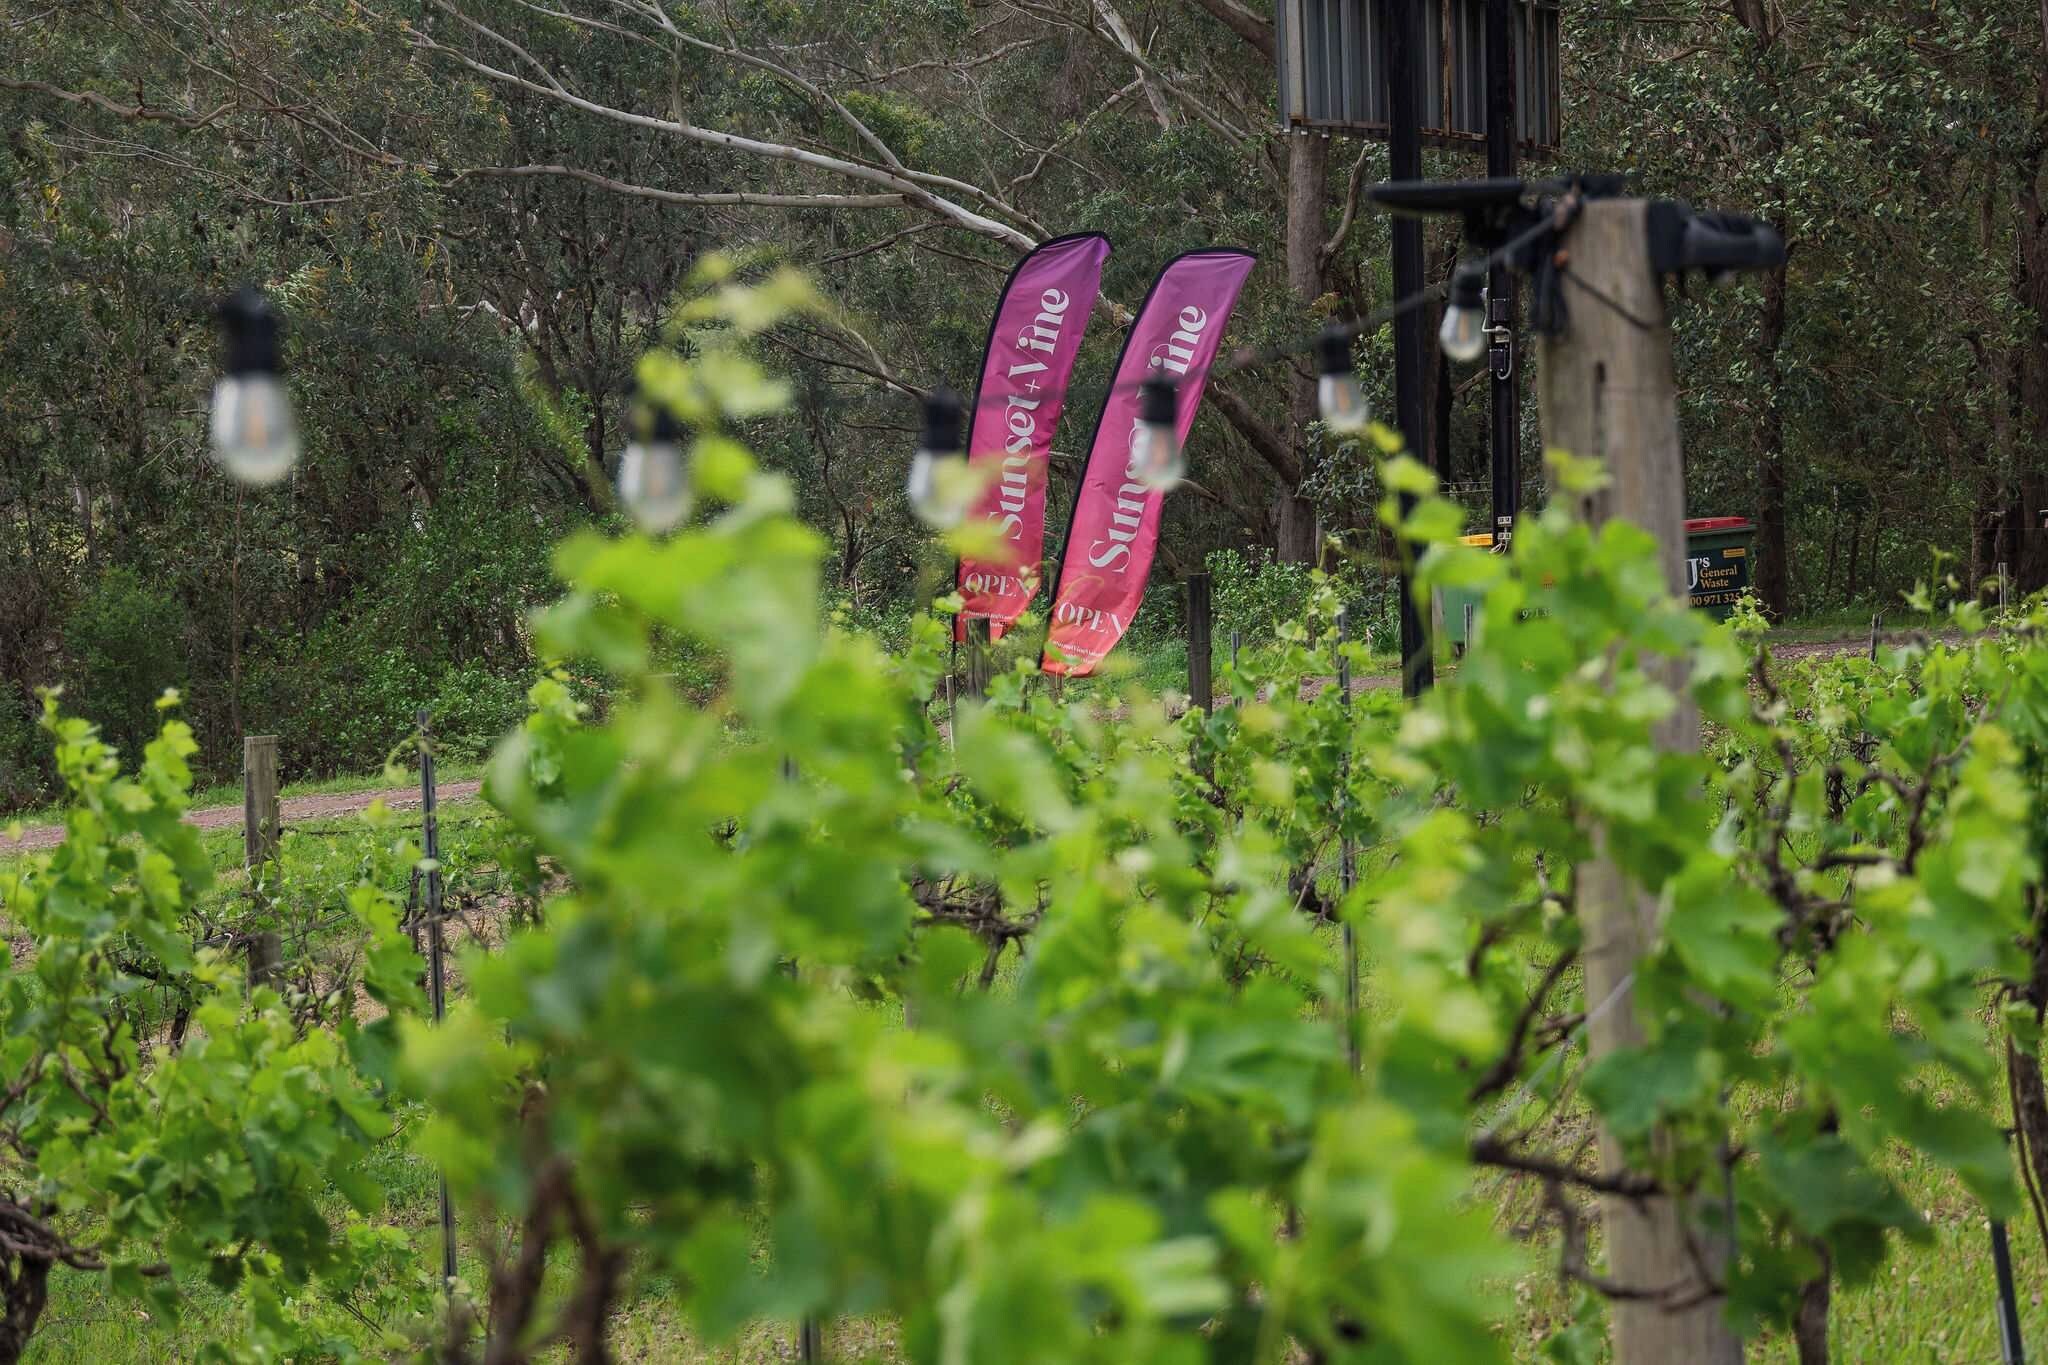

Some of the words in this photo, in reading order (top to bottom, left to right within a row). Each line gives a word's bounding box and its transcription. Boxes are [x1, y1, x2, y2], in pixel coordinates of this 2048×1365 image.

[1008, 288, 1070, 379] Vine
[1088, 416, 1157, 574] Sun
[1136, 305, 1207, 400] ine
[1700, 564, 1738, 578] General
[1700, 578, 1729, 590] Waste
[1703, 593, 1722, 606] 971
[1057, 600, 1128, 636] OPEN
